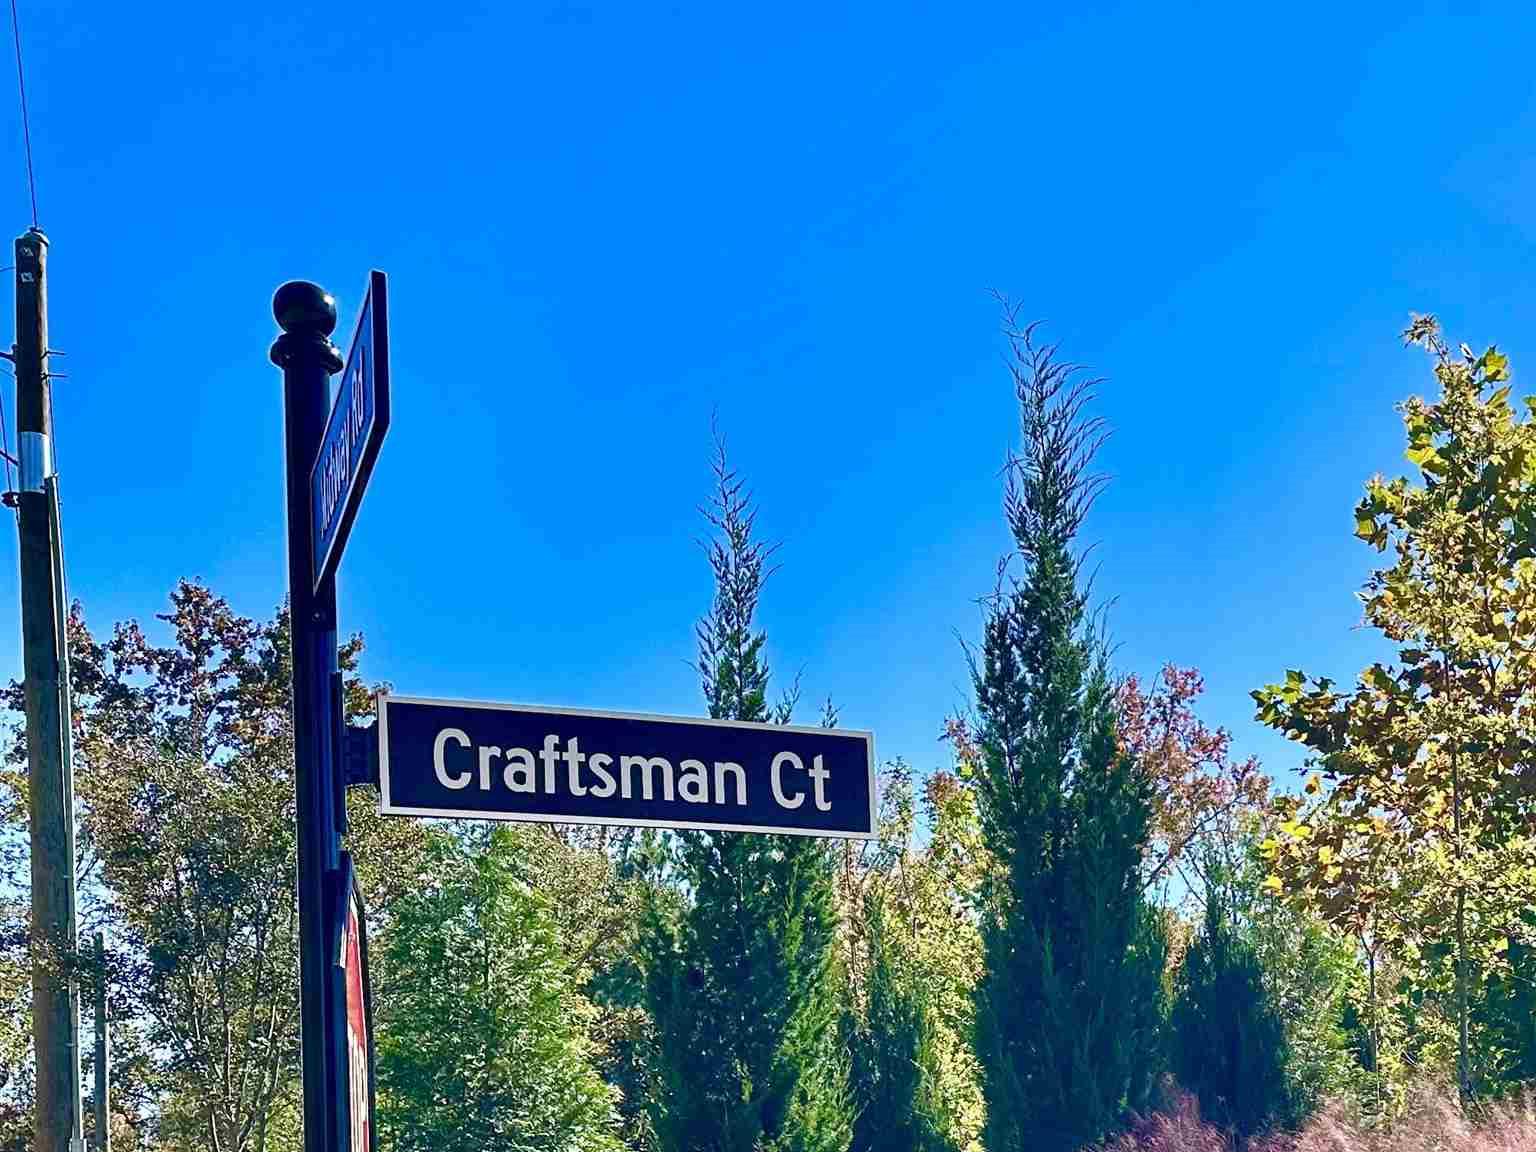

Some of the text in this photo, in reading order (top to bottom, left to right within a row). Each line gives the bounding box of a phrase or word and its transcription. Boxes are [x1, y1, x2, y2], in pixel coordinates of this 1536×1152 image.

[352, 346, 364, 447] Rd
[433, 727, 832, 812] Craftsman Ct
